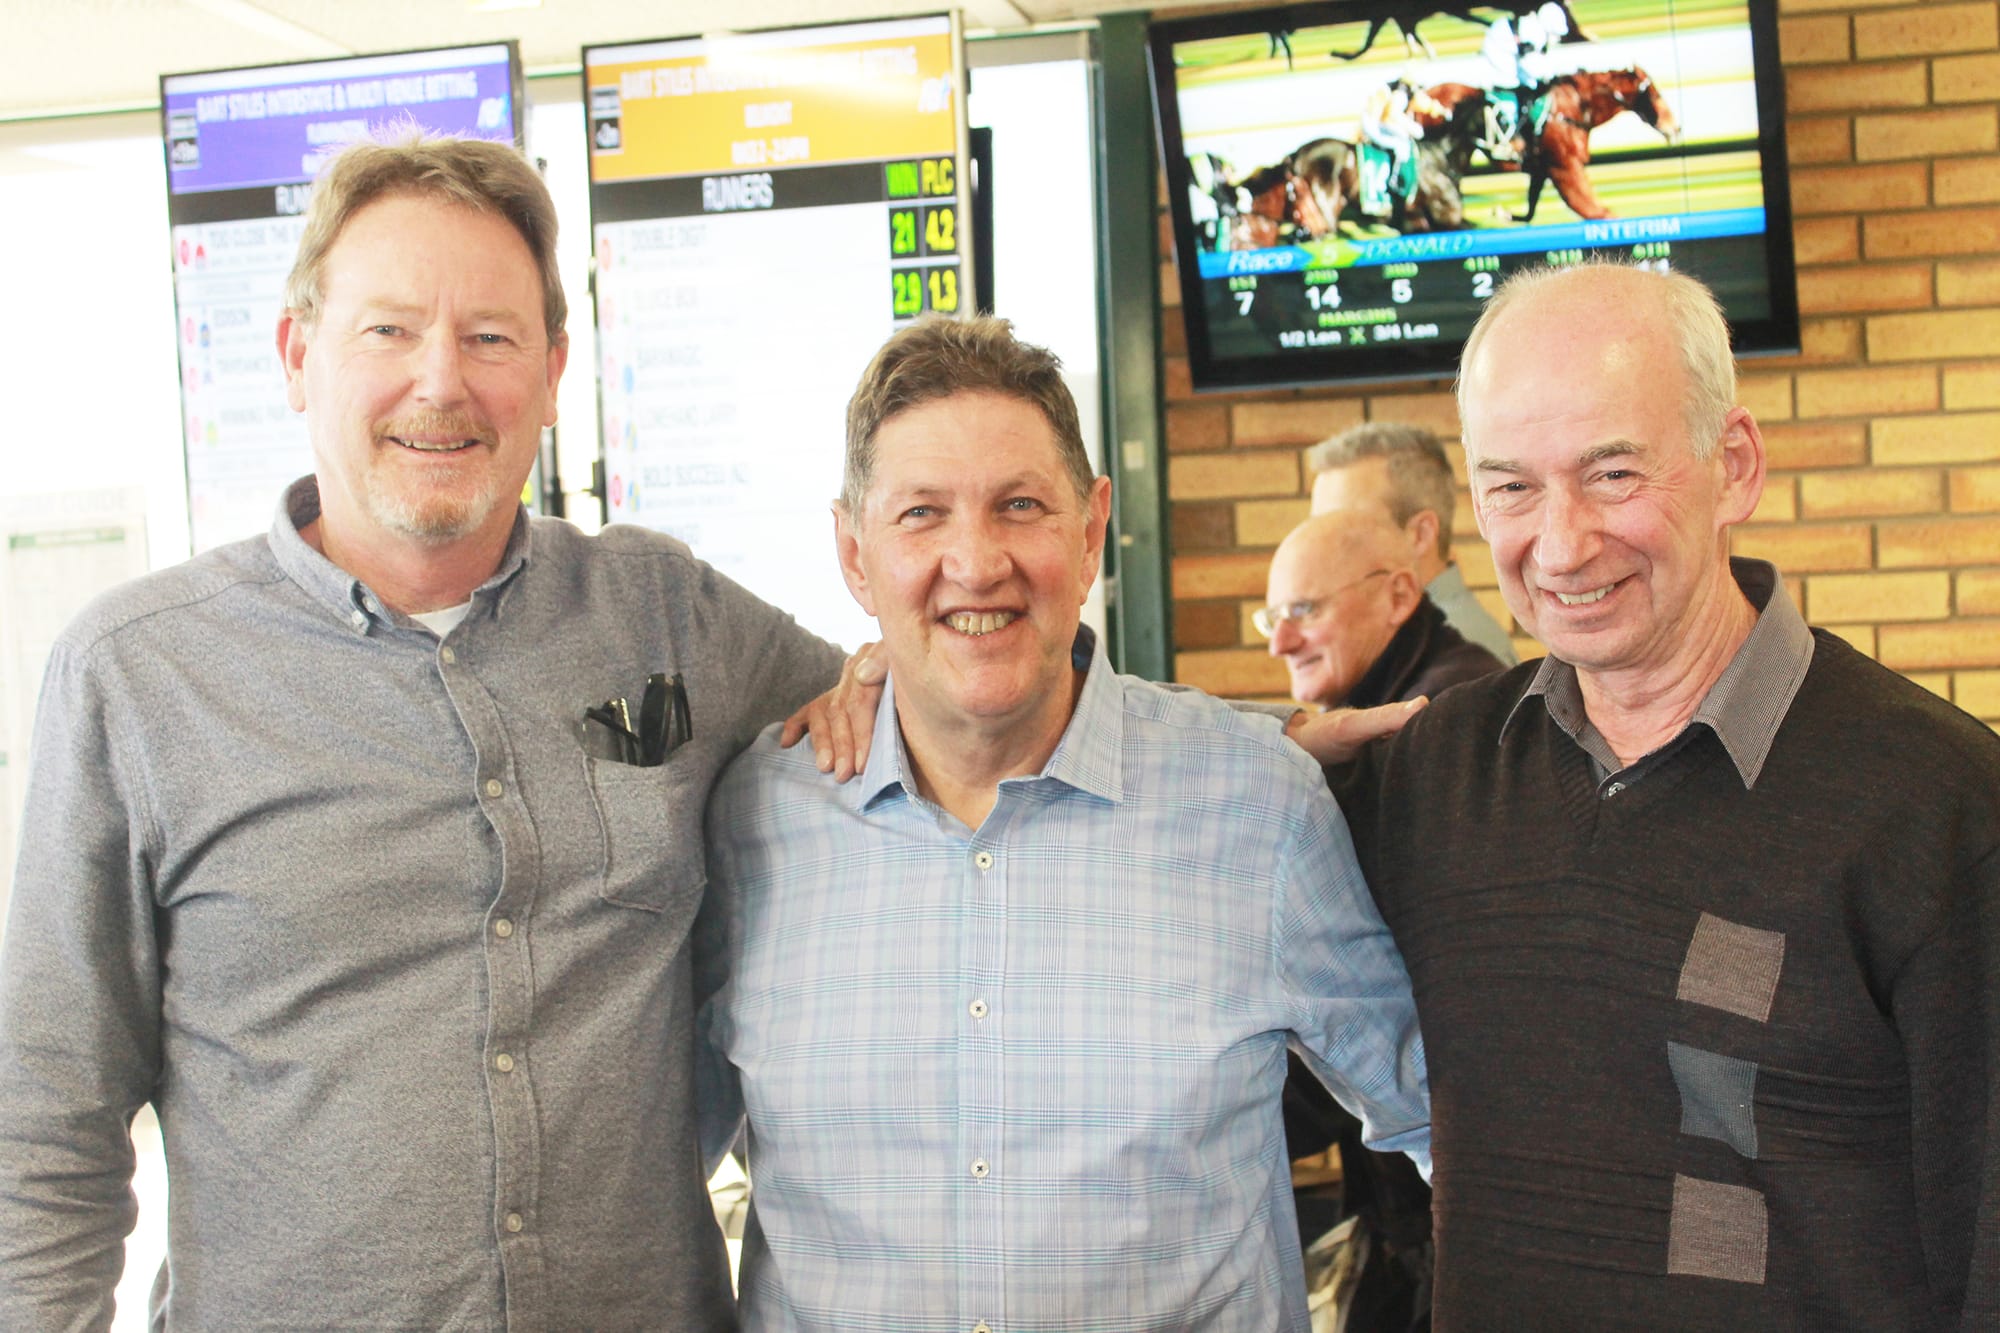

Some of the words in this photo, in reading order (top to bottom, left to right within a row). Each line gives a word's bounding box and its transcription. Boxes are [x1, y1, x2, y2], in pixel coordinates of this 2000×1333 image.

[922, 158, 954, 195] PLC
[702, 173, 774, 212] RUNNERS
[1585, 217, 1681, 241] INTERIM
[1227, 250, 1293, 273] Race
[1233, 291, 1255, 315] 7
[1305, 284, 1342, 310] 14
[1391, 279, 1413, 303] 5
[1471, 272, 1494, 298] 2
[1318, 307, 1397, 328] MARGINS
